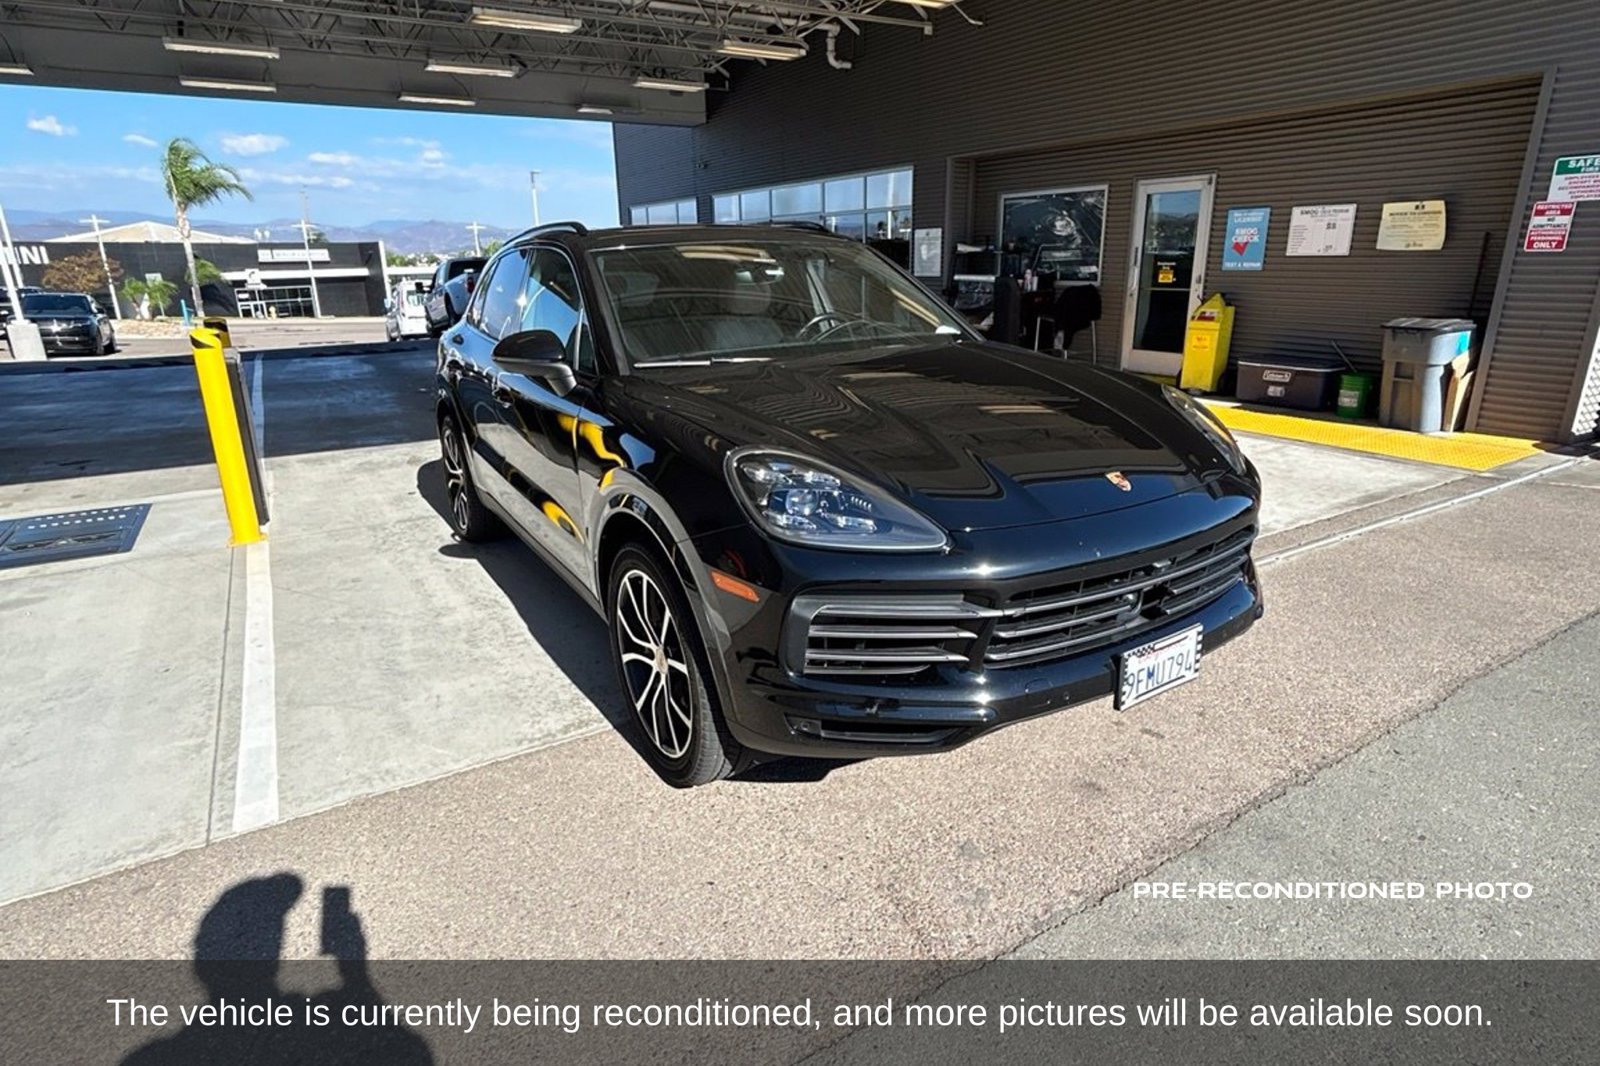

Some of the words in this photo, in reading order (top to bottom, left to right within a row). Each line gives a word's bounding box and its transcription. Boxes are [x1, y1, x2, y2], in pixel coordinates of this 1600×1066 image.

[1235, 227, 1258, 235] SMOG
[1232, 234, 1260, 243] CHECK
[1533, 241, 1558, 249] ONLY
[1126, 649, 1192, 699] 9FMU794
